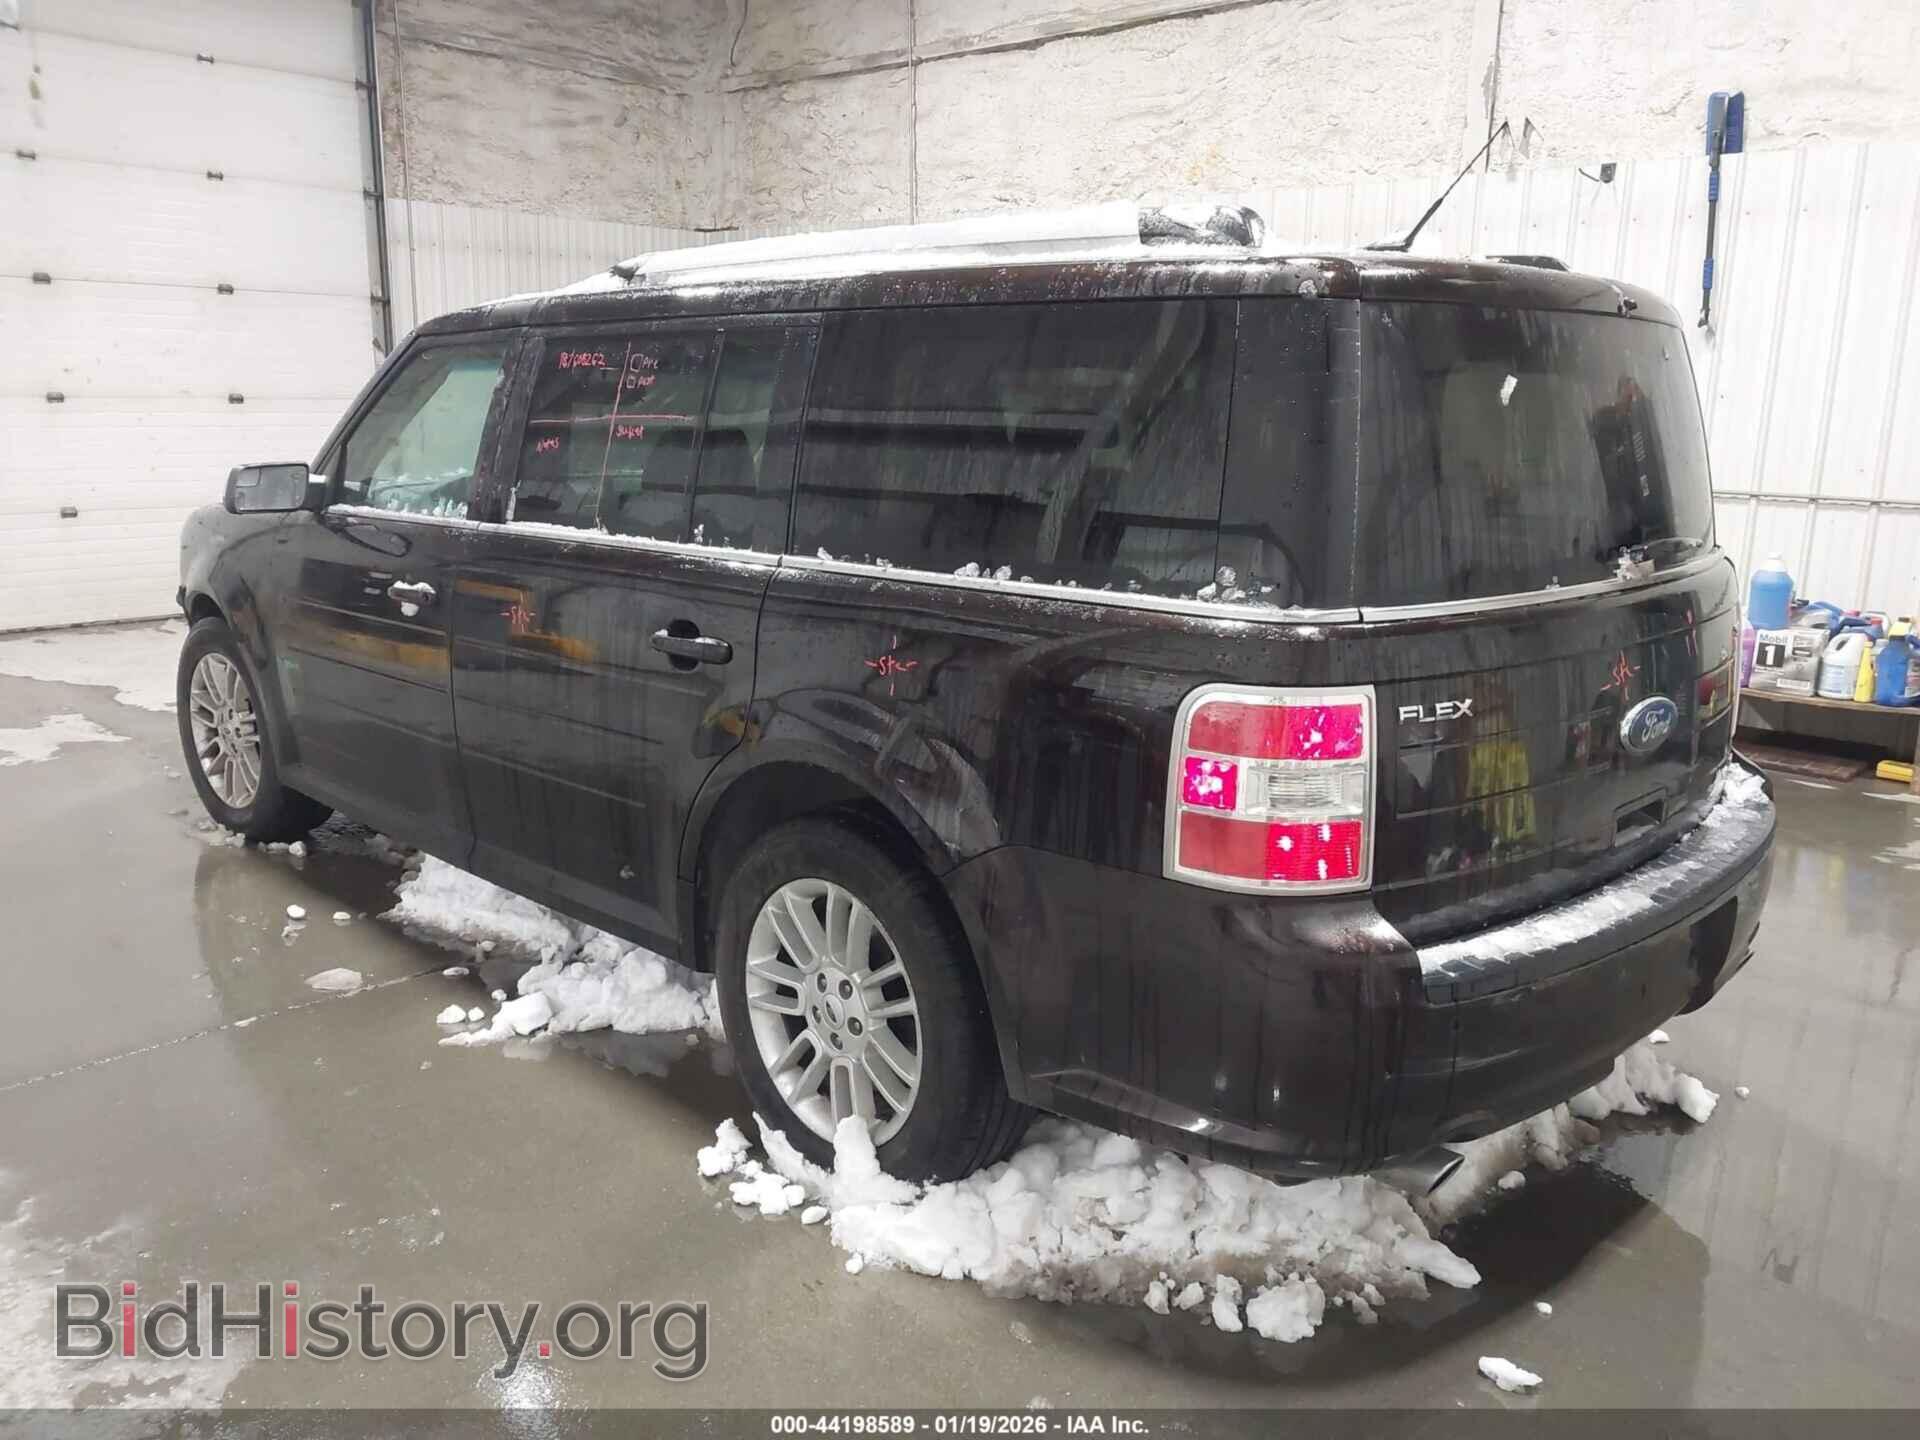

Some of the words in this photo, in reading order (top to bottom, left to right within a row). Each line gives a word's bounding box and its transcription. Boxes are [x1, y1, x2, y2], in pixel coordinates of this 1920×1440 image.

[1758, 632, 1788, 644] Mobil
[1764, 645, 1776, 666] 1
[1399, 698, 1473, 725] FLEX
[1641, 707, 1673, 743] Ford
